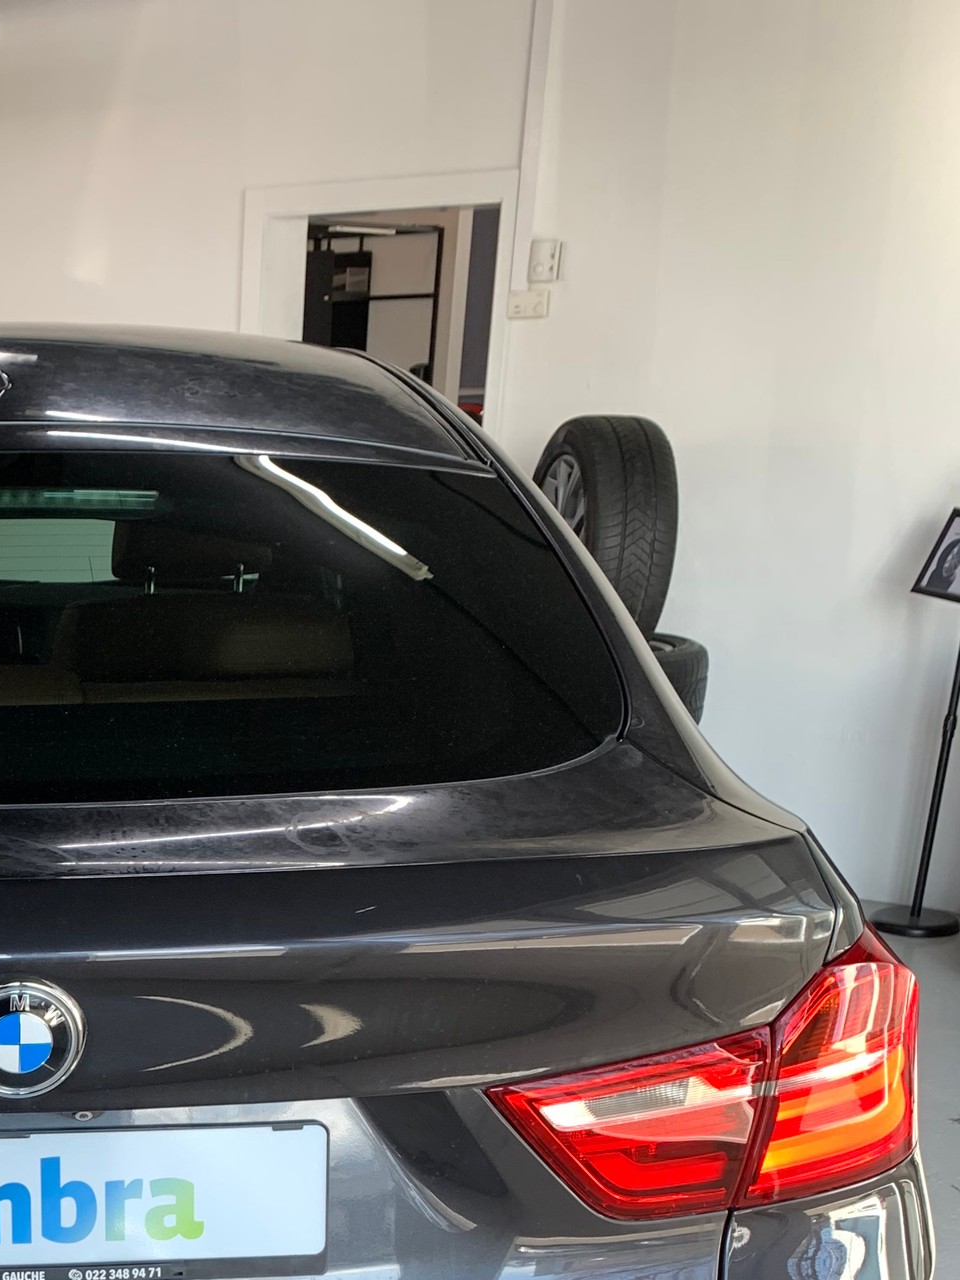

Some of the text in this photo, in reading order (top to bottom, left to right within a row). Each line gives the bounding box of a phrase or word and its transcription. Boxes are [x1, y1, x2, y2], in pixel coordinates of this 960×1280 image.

[85, 1269, 106, 1280] 022
[108, 1268, 130, 1280] 348
[131, 1267, 147, 1279] 94
[148, 1267, 162, 1278] 71
